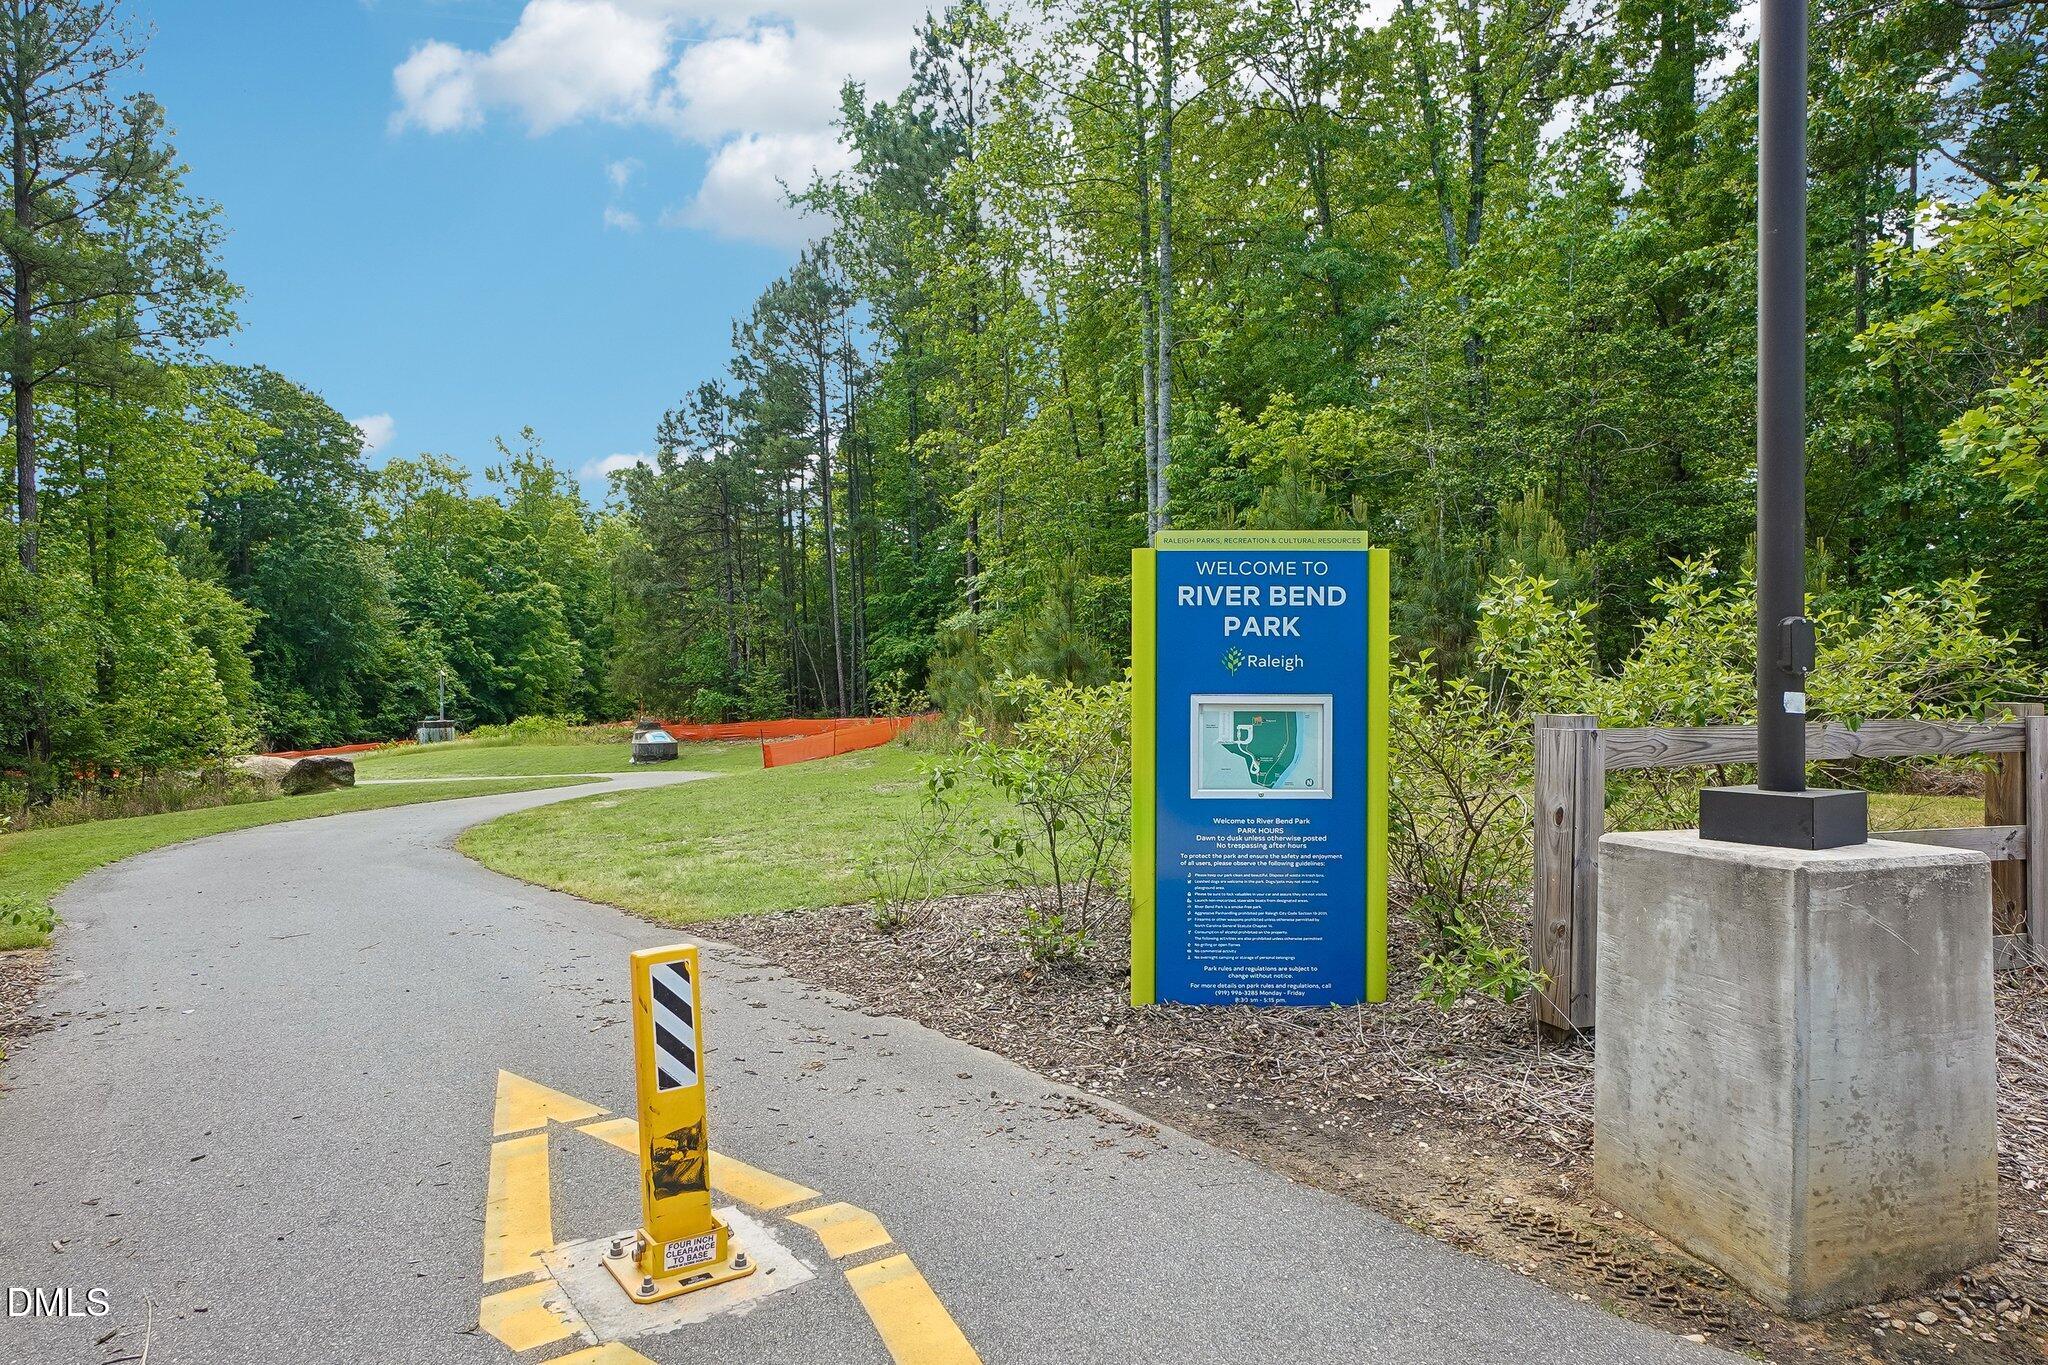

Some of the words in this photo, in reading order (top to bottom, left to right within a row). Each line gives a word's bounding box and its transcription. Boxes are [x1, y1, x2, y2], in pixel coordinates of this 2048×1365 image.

[1196, 561, 1296, 575] WELCOME
[1302, 561, 1328, 575] TO
[1178, 586, 1260, 606] RIVER
[1270, 586, 1347, 606] BEND
[1224, 616, 1300, 636] PARK
[1248, 654, 1304, 671] Raleigh
[666, 1242, 715, 1258] CLEARANCE
[669, 1240, 691, 1250] FOUR
[694, 1235, 713, 1245] INCH
[687, 1251, 708, 1261] BASE
